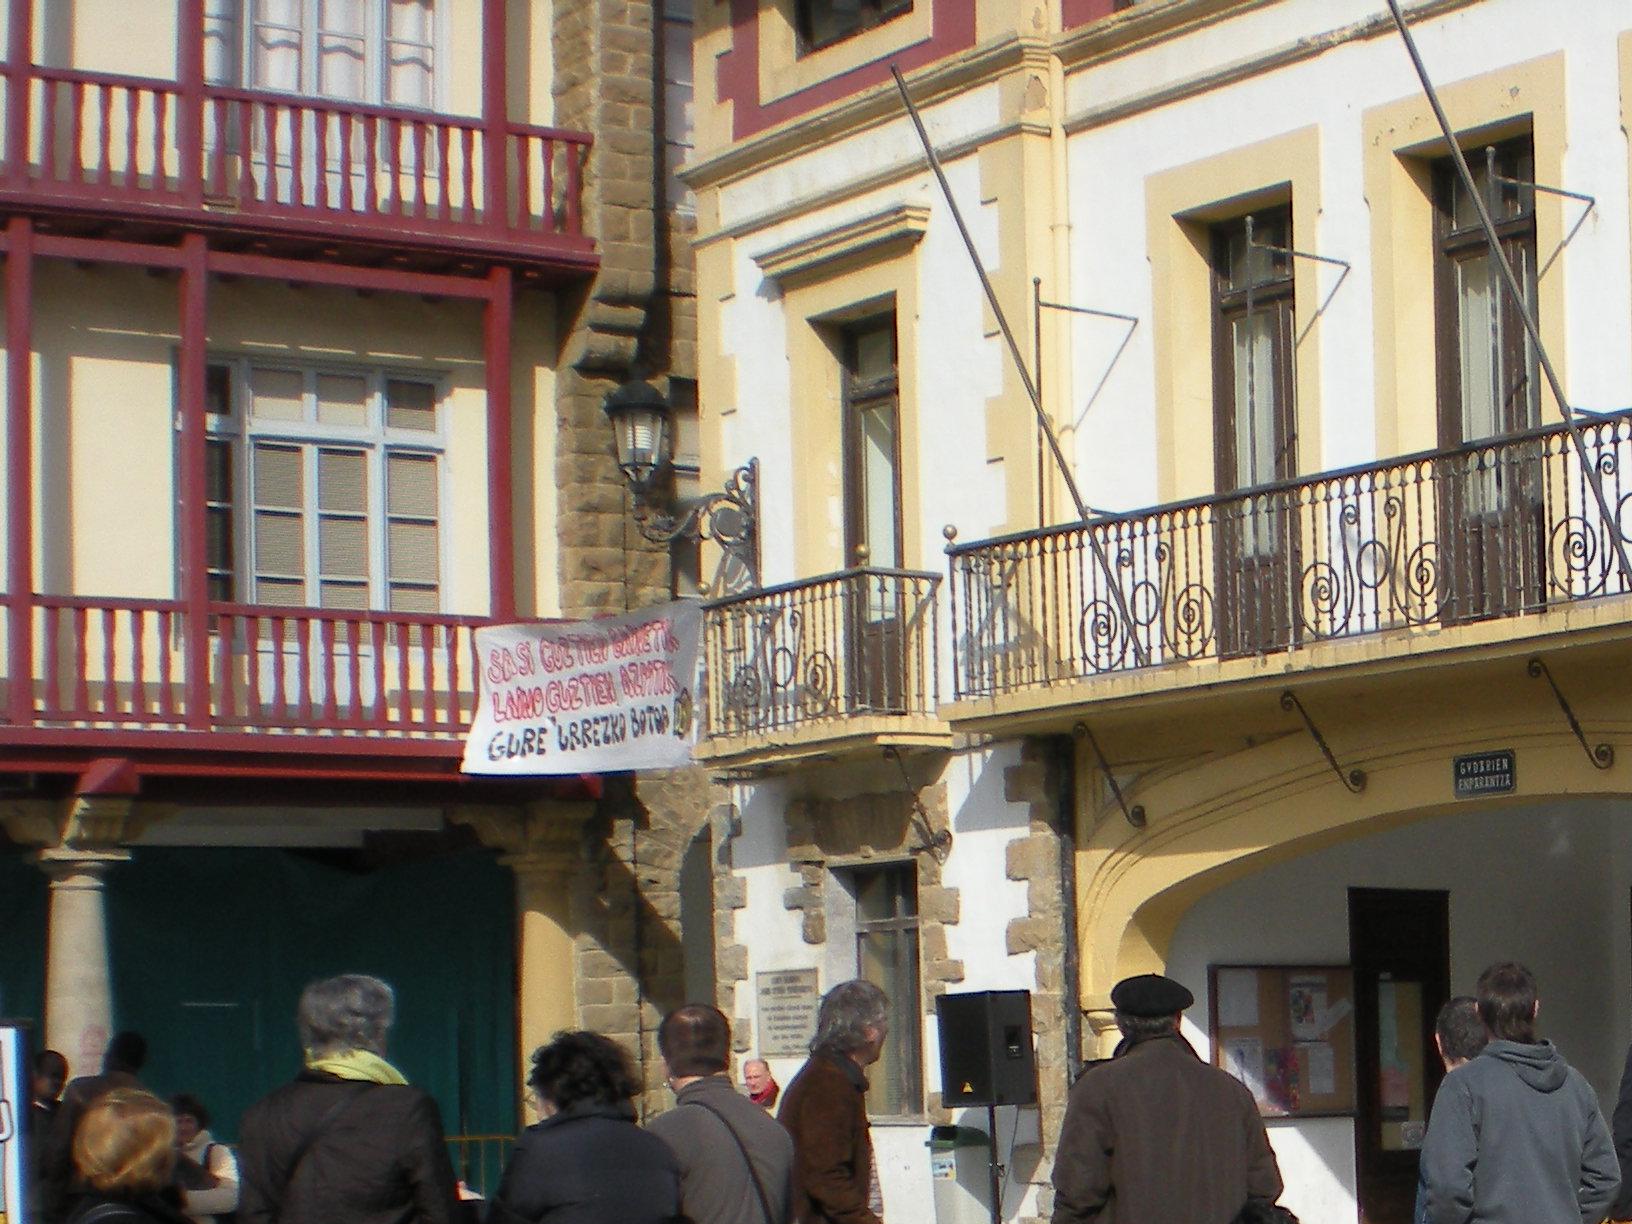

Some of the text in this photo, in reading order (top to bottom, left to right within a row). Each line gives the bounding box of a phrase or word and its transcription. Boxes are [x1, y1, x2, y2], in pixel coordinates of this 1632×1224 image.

[488, 642, 536, 684] SASI
[545, 673, 617, 713] GUZTIEN
[488, 727, 547, 761] GURE
